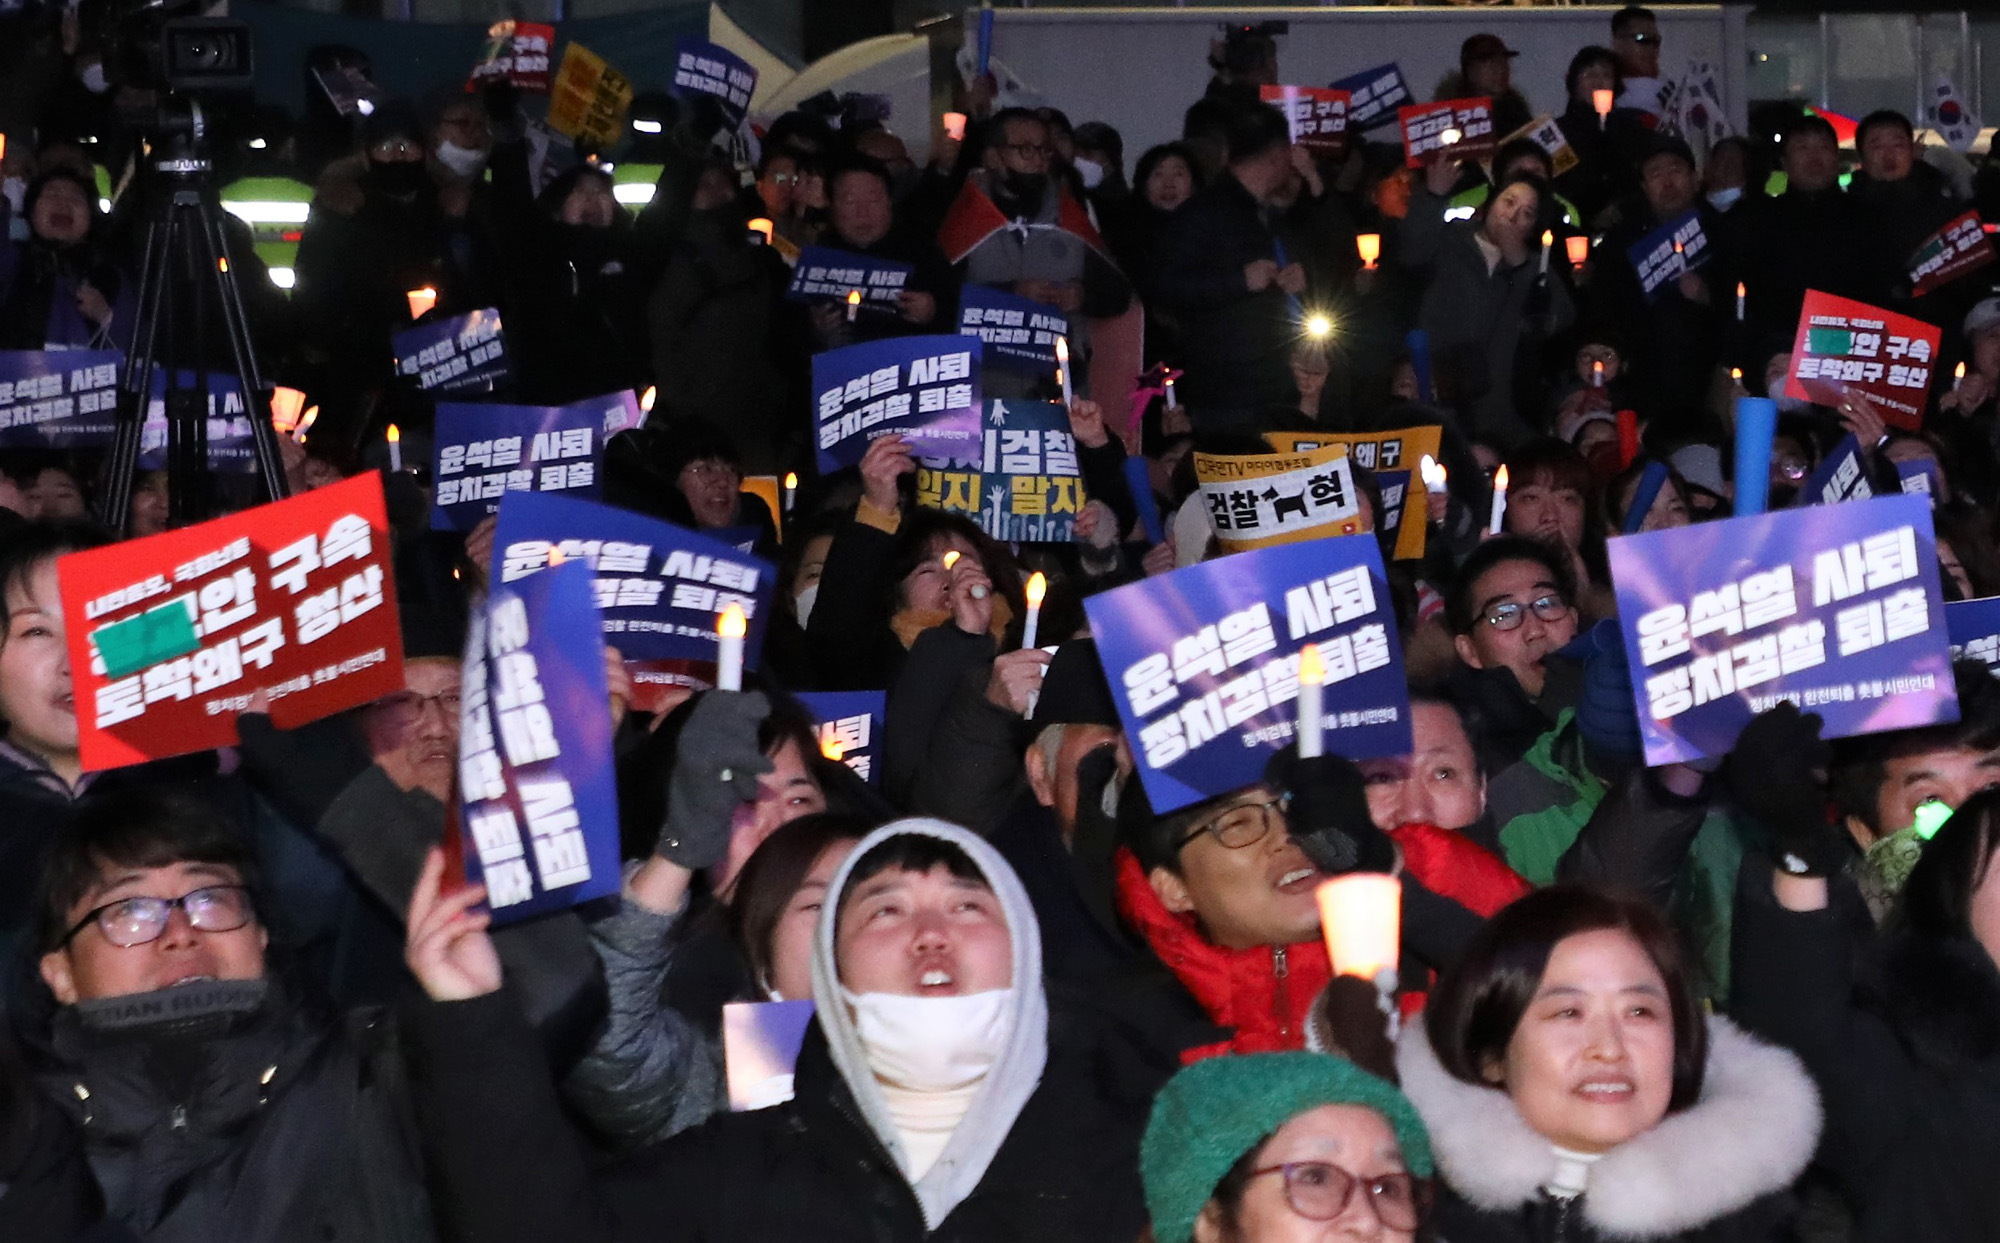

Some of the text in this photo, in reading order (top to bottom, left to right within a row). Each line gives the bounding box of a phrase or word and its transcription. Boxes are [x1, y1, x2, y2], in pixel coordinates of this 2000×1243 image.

[963, 307, 1025, 327] 윤석열
[1796, 358, 1929, 389] 토착왜구 청산
[1885, 335, 1932, 364] 구속
[70, 364, 117, 393] 사퇴
[79, 389, 117, 415] 퇴출
[819, 352, 971, 422] 윤석열 사퇴
[819, 384, 973, 451] 정치검찰 퇴출
[439, 427, 593, 476] 윤석열 사퇴
[436, 461, 595, 507] 정치검찰 퇴출
[1010, 475, 1087, 515] 말자
[1206, 470, 1346, 530] 검찰 혁
[268, 513, 373, 595] 구속
[660, 550, 761, 593] 사퇴
[1636, 525, 1920, 668] 윤석열 사퇴
[95, 616, 287, 731] 토착왜구
[294, 562, 384, 646] 청산
[1122, 564, 1377, 718] 윤석열 사퇴
[1644, 586, 1931, 722] 정치검찰 퇴출
[1138, 651, 1303, 770] 정치검찰
[1804, 685, 1856, 707] 완전퇴출
[1857, 673, 1937, 701] 촛불시민연대
[1241, 720, 1293, 748] 정치검찰
[516, 777, 593, 892] 사퇴
